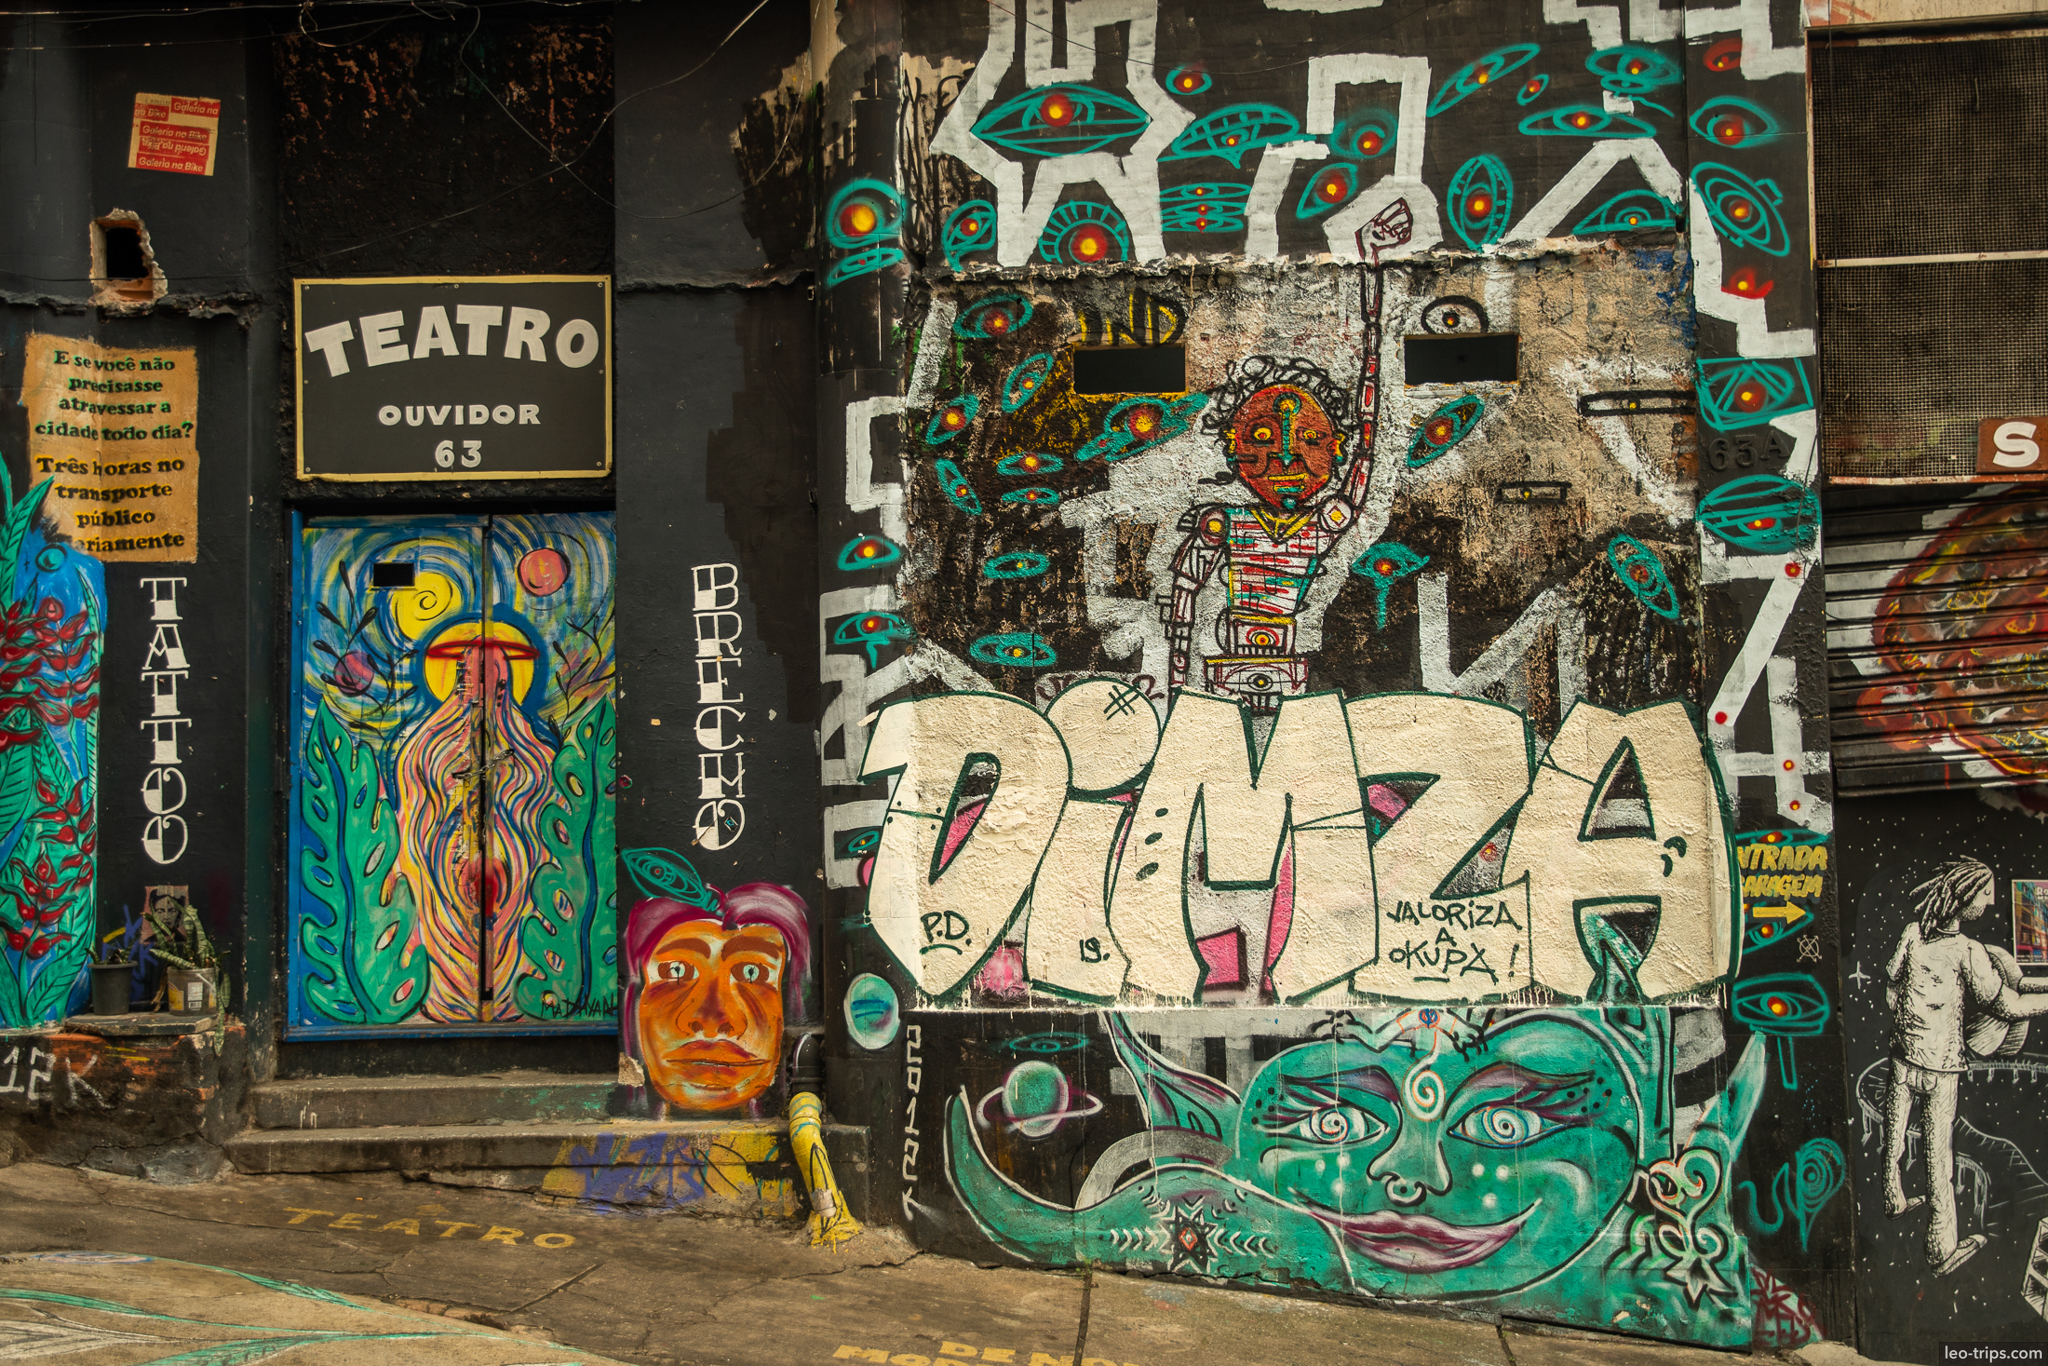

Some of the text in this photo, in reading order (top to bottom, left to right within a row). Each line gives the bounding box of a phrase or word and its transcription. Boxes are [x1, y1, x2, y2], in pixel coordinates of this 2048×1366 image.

[148, 108, 166, 118] Bike
[174, 101, 205, 113] Galeria
[207, 107, 218, 115] na
[142, 125, 174, 136] Galeria
[189, 130, 207, 141] Bike
[139, 157, 203, 172] Galeria na Bike
[304, 303, 599, 378] TEATRO
[53, 350, 175, 372] E se você não
[67, 377, 163, 393] precisasse
[58, 397, 172, 415] atravessar a
[378, 403, 541, 427] OUVIDOR
[35, 420, 99, 441] cidade
[152, 421, 194, 441] dia?
[435, 439, 482, 468] 63
[1709, 430, 1791, 471] 63A
[1992, 421, 2040, 468] S
[35, 455, 185, 476] Três horas no
[54, 483, 173, 504] transporte
[75, 508, 156, 529] público
[140, 577, 192, 865] TATTOO
[1737, 843, 1828, 871] NTRADA
[1436, 927, 1457, 947] A
[283, 1206, 577, 1249] TEATRO
